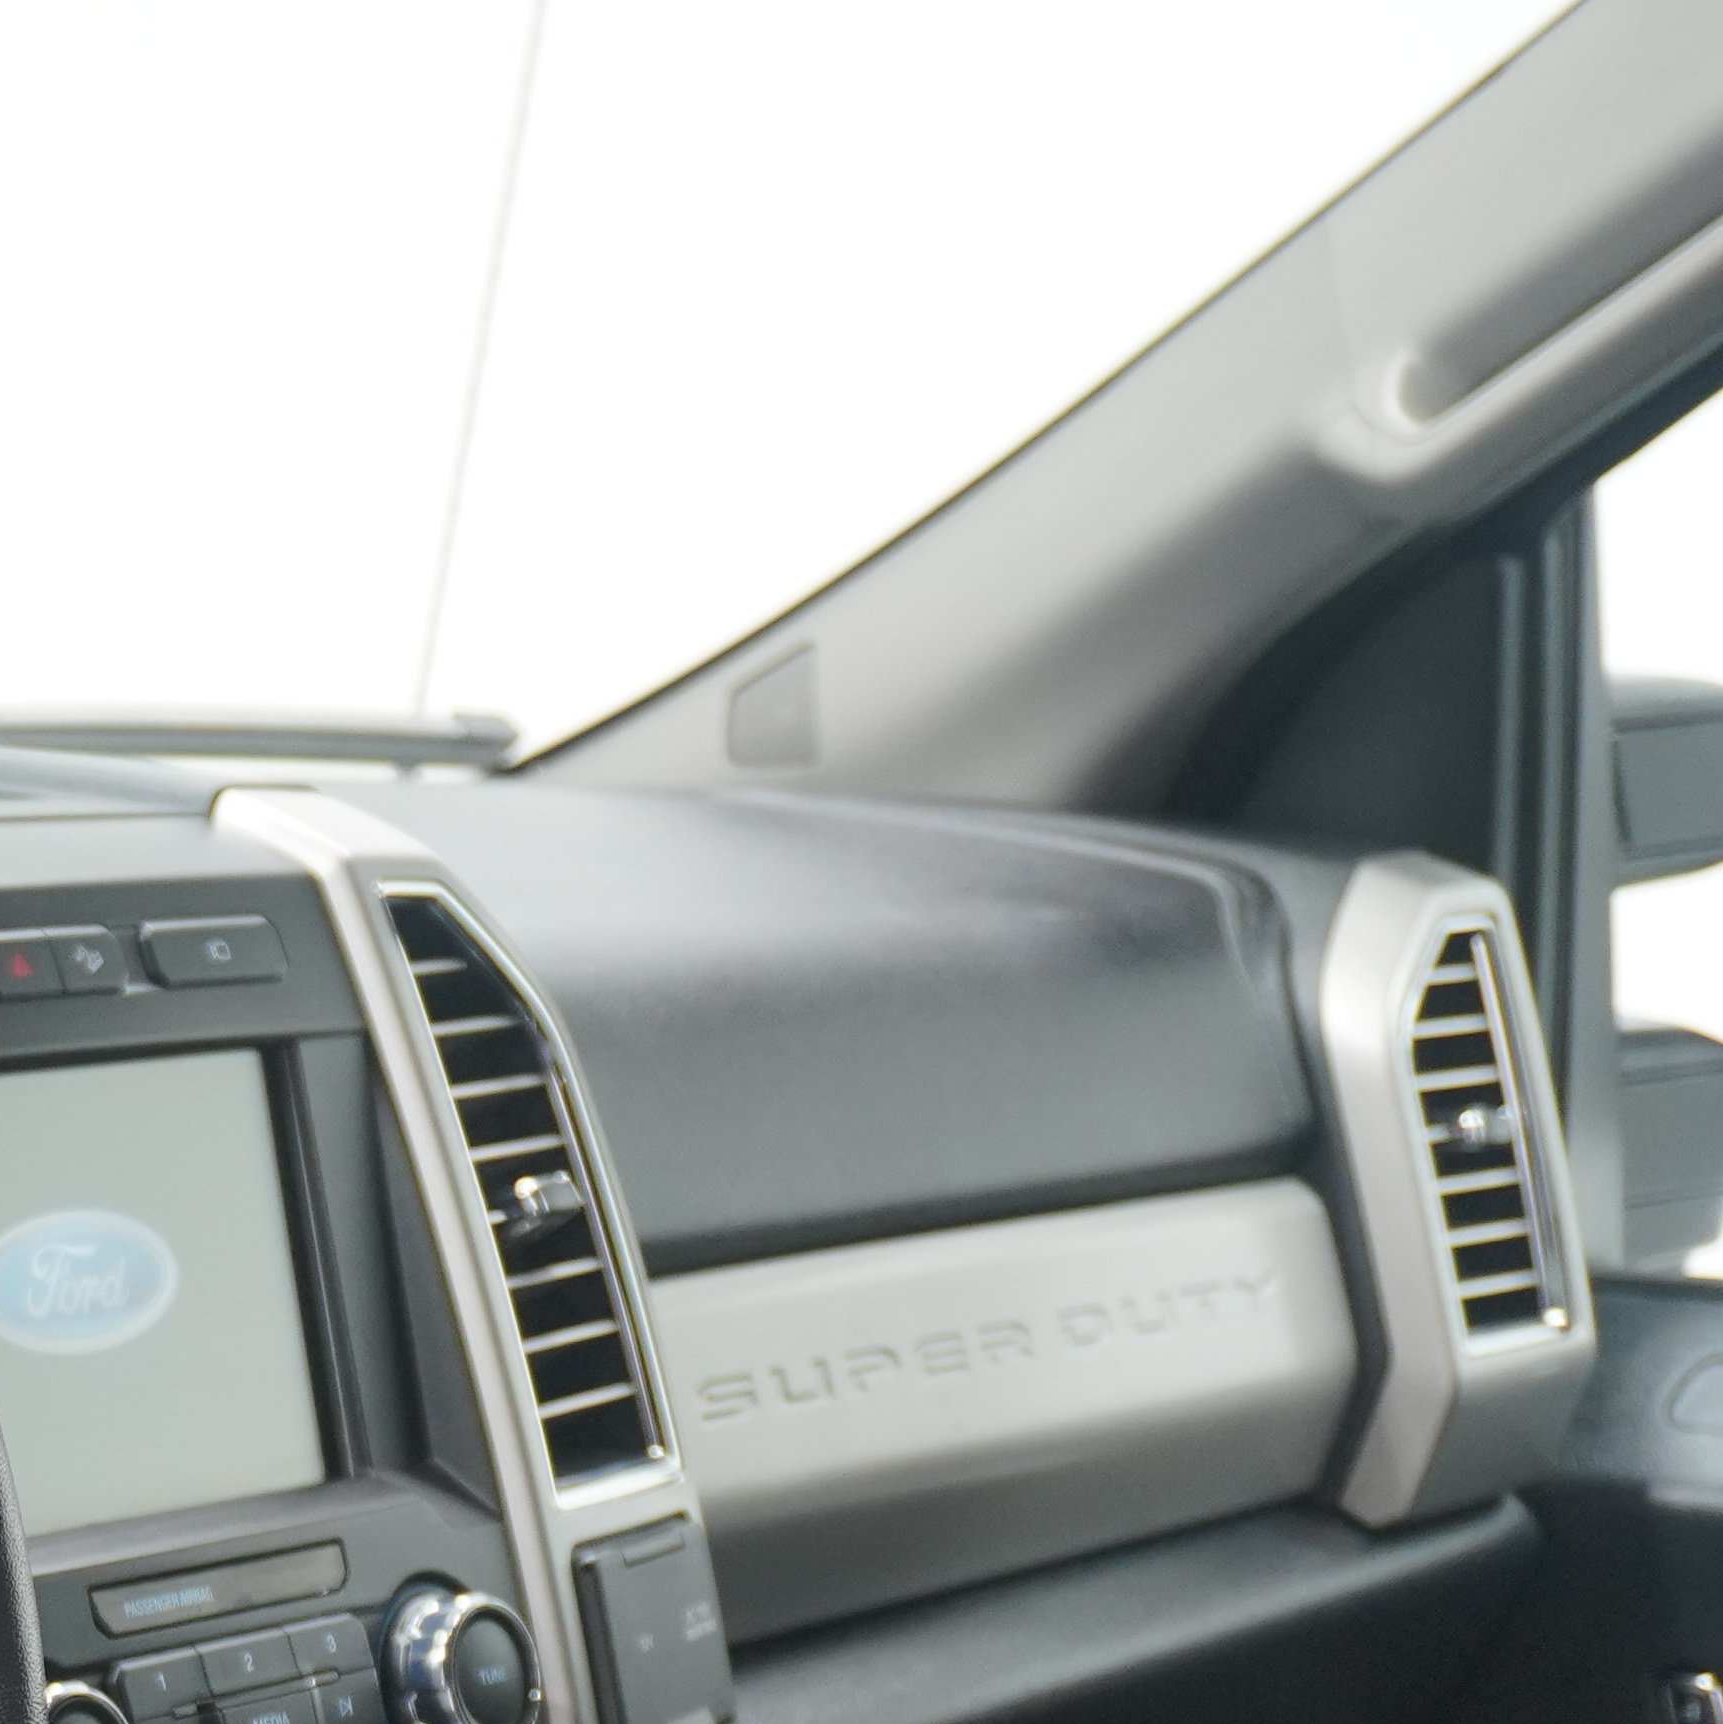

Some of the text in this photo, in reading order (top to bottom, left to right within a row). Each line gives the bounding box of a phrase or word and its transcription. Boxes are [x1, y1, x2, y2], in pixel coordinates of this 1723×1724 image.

[26, 1242, 131, 1318] Ford
[698, 1273, 1277, 1421] SUPER DUTY
[326, 1634, 337, 1653] 3
[243, 1653, 254, 1673] 2
[158, 1672, 167, 1692] 1
[477, 1667, 506, 1686] TUNE
